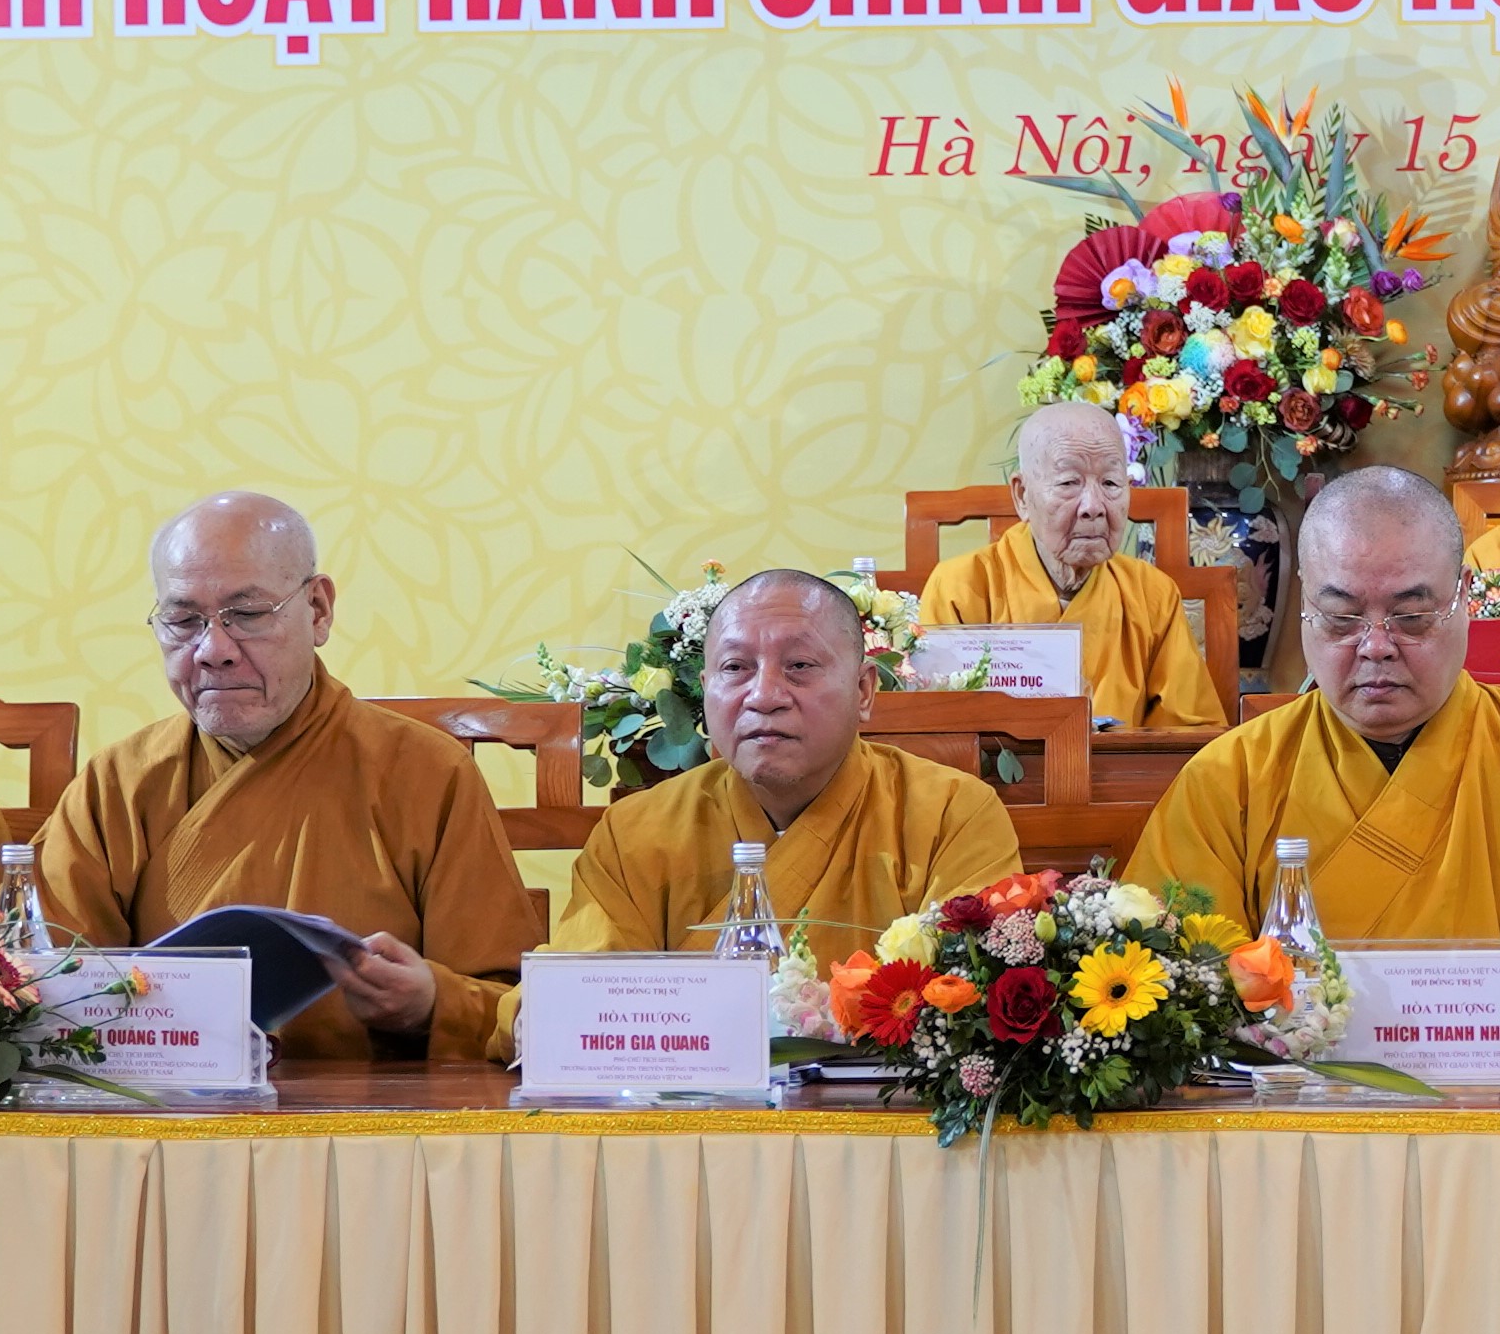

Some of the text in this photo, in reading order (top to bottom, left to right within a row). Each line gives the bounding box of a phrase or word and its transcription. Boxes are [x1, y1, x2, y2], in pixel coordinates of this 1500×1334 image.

[870, 116, 976, 178] Hà
[1399, 115, 1480, 173] 15
[84, 1004, 174, 1021] HÒA THƯỢNG
[599, 1010, 691, 1025] HÒA THƯỢNG
[1402, 1001, 1496, 1016] HÒA THƯỢNG
[107, 1025, 156, 1046] QUẢNG
[162, 1027, 199, 1046] TÙNG
[580, 1032, 710, 1052] THÍCH GIA QUANG
[1374, 1023, 1419, 1042] THÍCH
[1425, 1025, 1474, 1042] THANH
